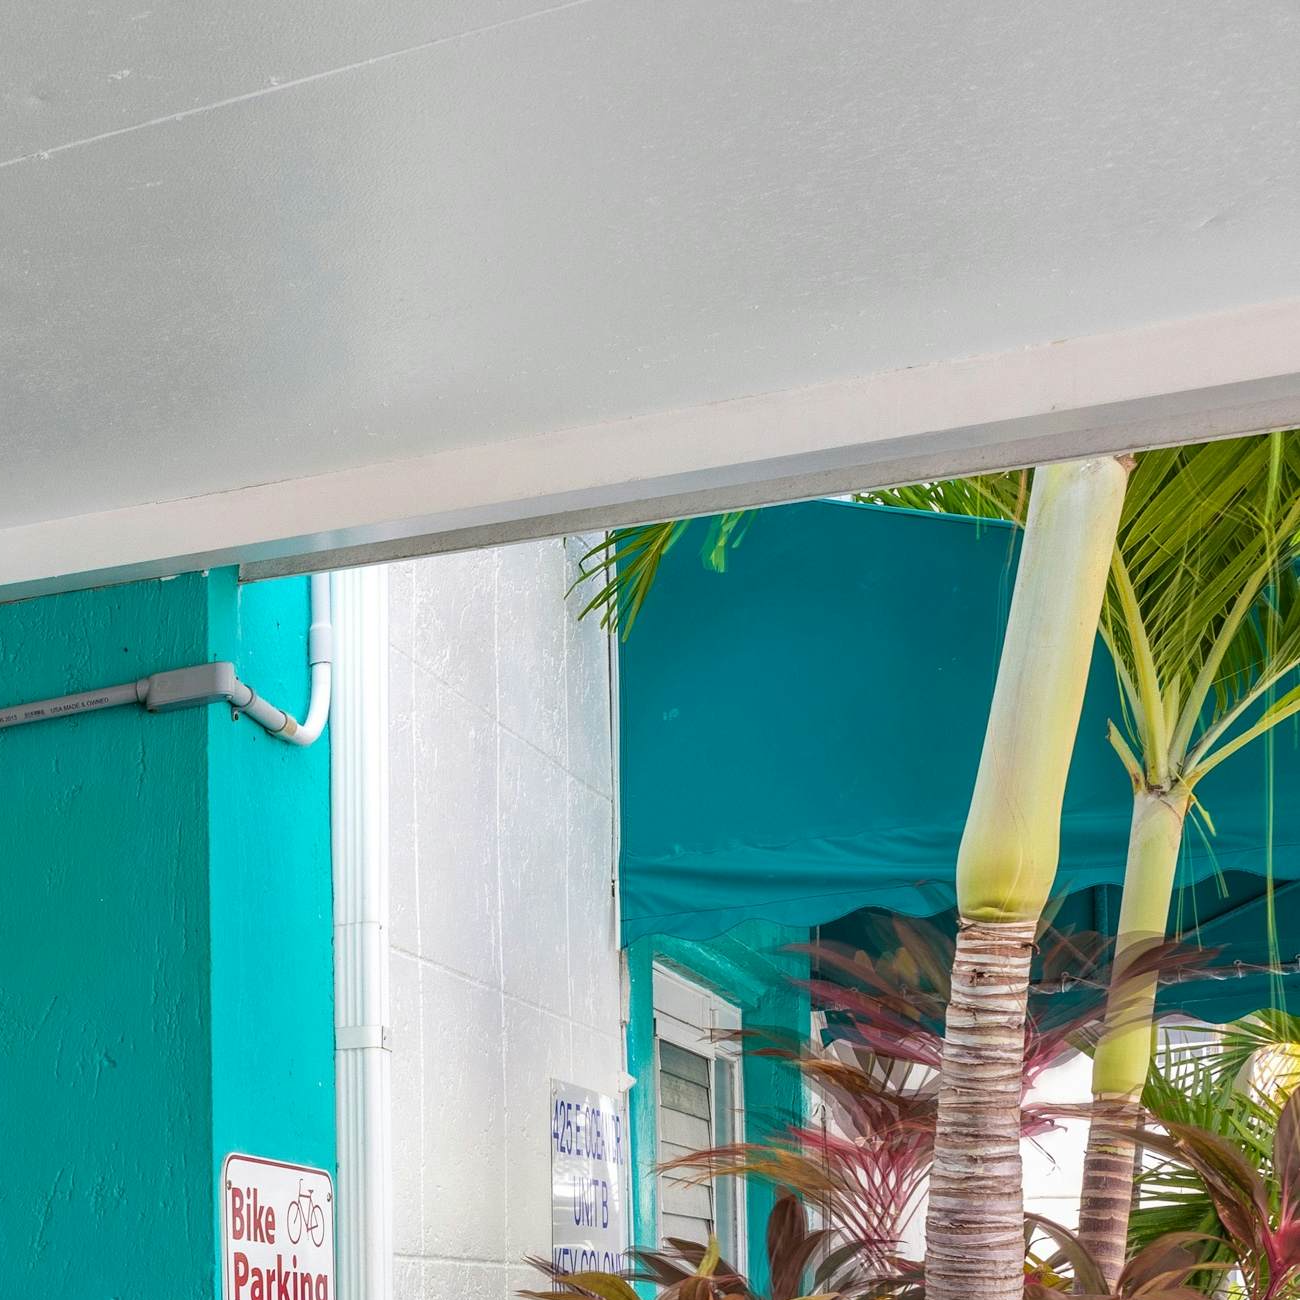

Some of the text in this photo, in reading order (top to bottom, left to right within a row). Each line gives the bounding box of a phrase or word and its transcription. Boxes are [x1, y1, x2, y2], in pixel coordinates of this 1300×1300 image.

[553, 1099, 572, 1155] 425
[576, 1103, 582, 1156] E
[231, 1187, 275, 1245] Bike
[573, 1175, 609, 1229] UNIT B
